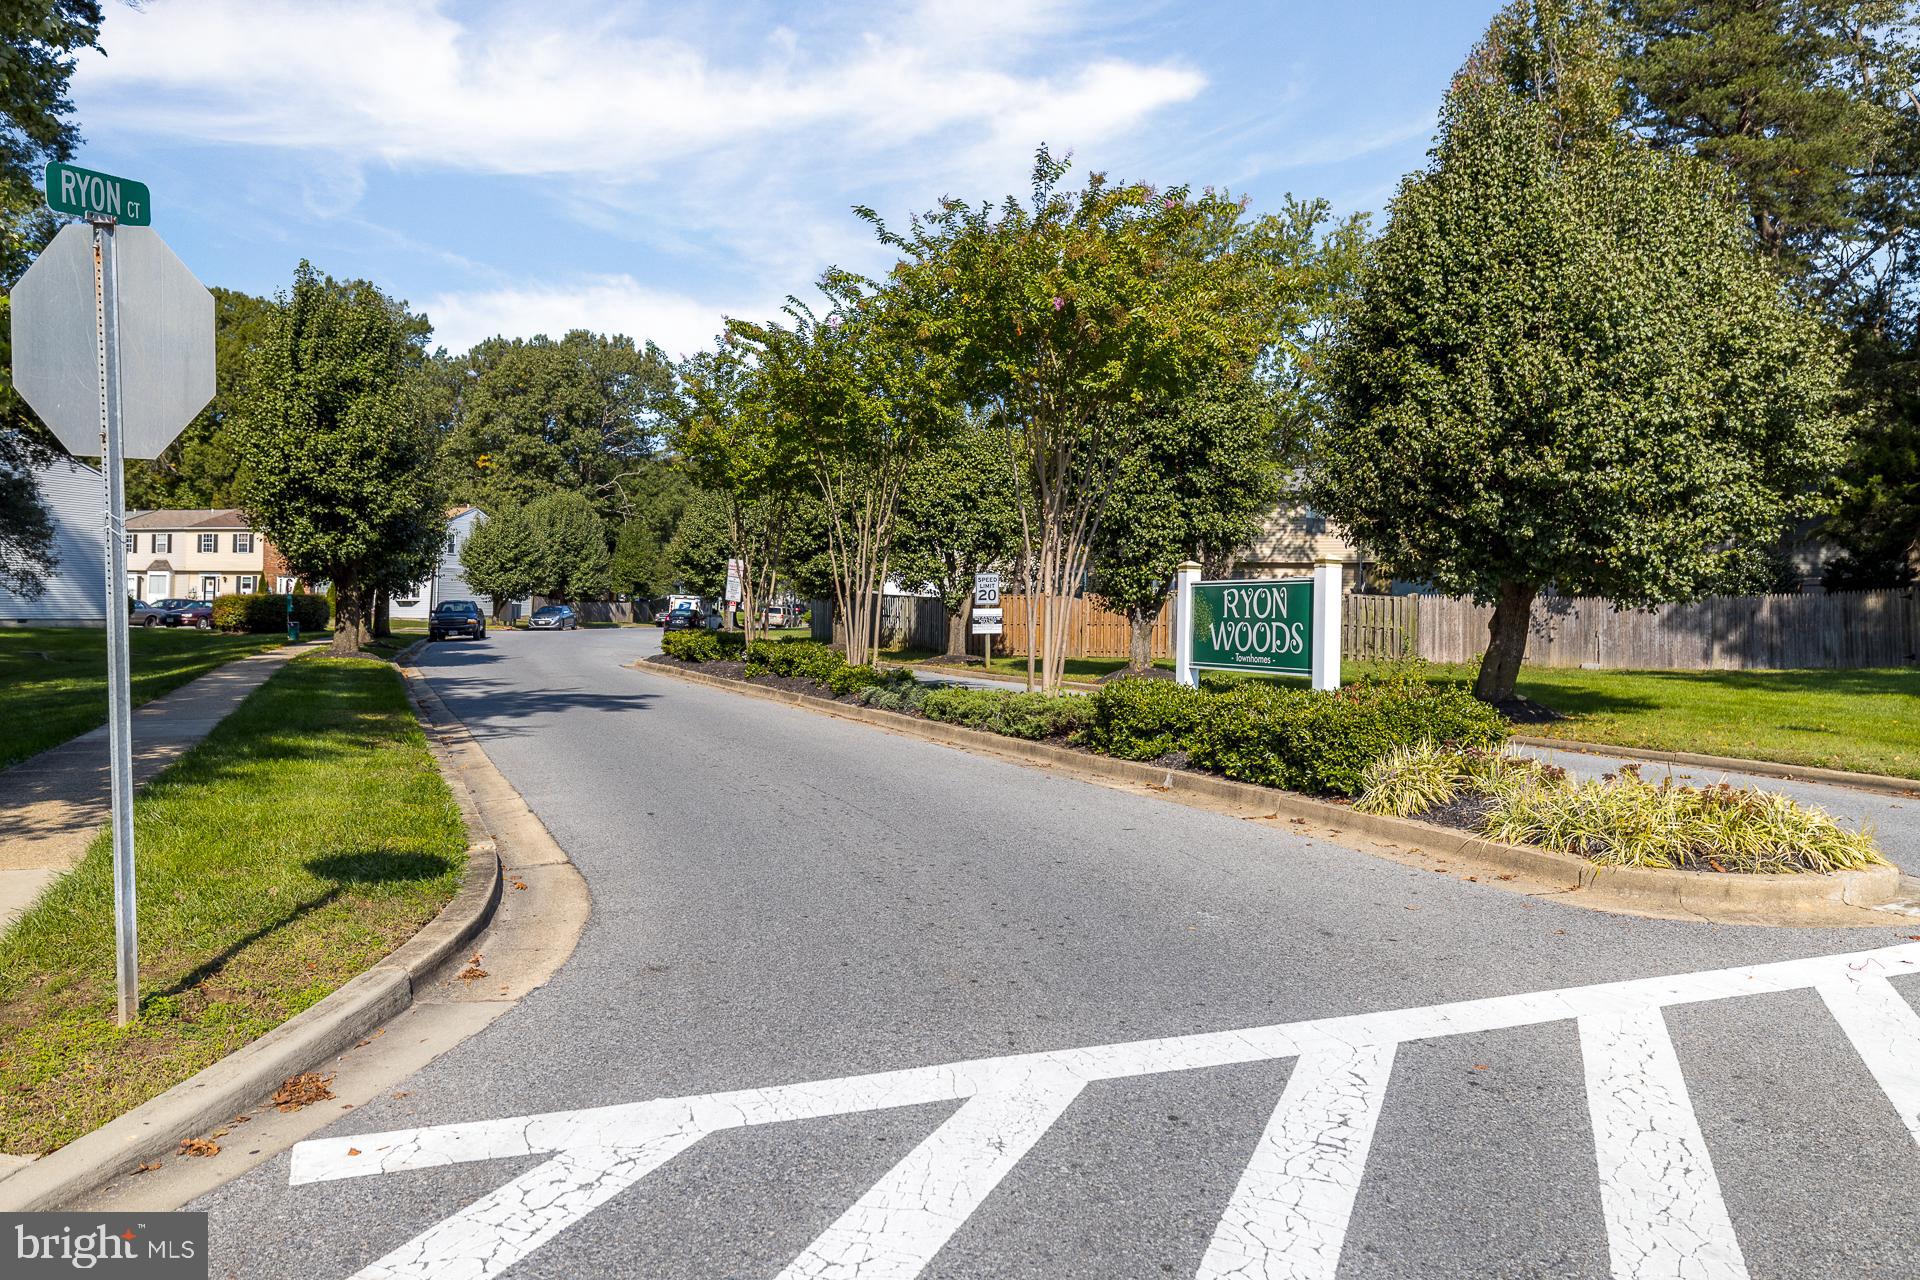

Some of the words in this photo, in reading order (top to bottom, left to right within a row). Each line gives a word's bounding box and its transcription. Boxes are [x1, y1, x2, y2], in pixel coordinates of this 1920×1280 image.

[60, 169, 121, 216] RYON
[127, 201, 141, 219] CT
[978, 589, 997, 601] 20
[1222, 586, 1288, 620] RYON
[1208, 620, 1304, 655] WOODS
[1235, 652, 1271, 664] Townhomes
